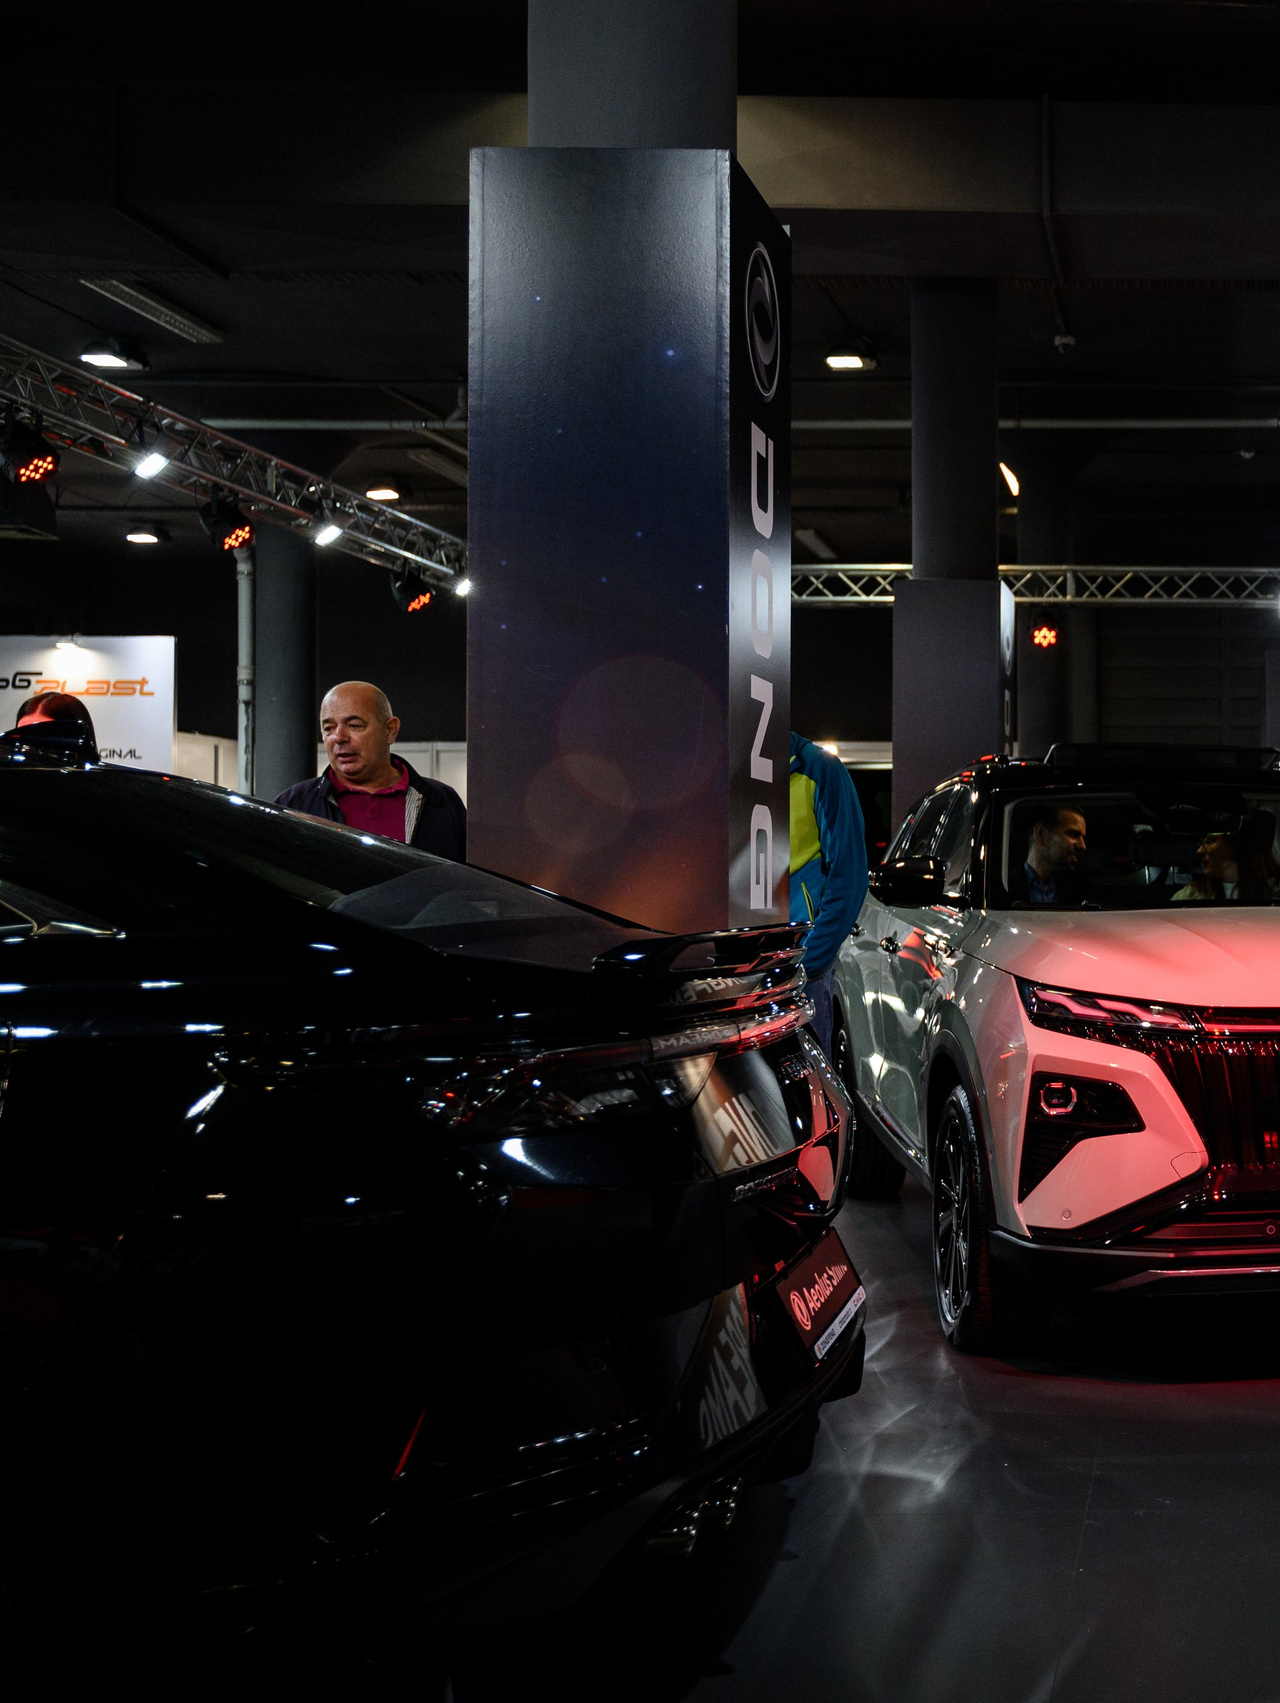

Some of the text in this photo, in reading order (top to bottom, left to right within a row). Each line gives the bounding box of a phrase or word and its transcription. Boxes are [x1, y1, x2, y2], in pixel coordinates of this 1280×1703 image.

[750, 421, 775, 910] DONG
[99, 747, 143, 760] GINAL
[803, 1272, 834, 1316] Aeolus
